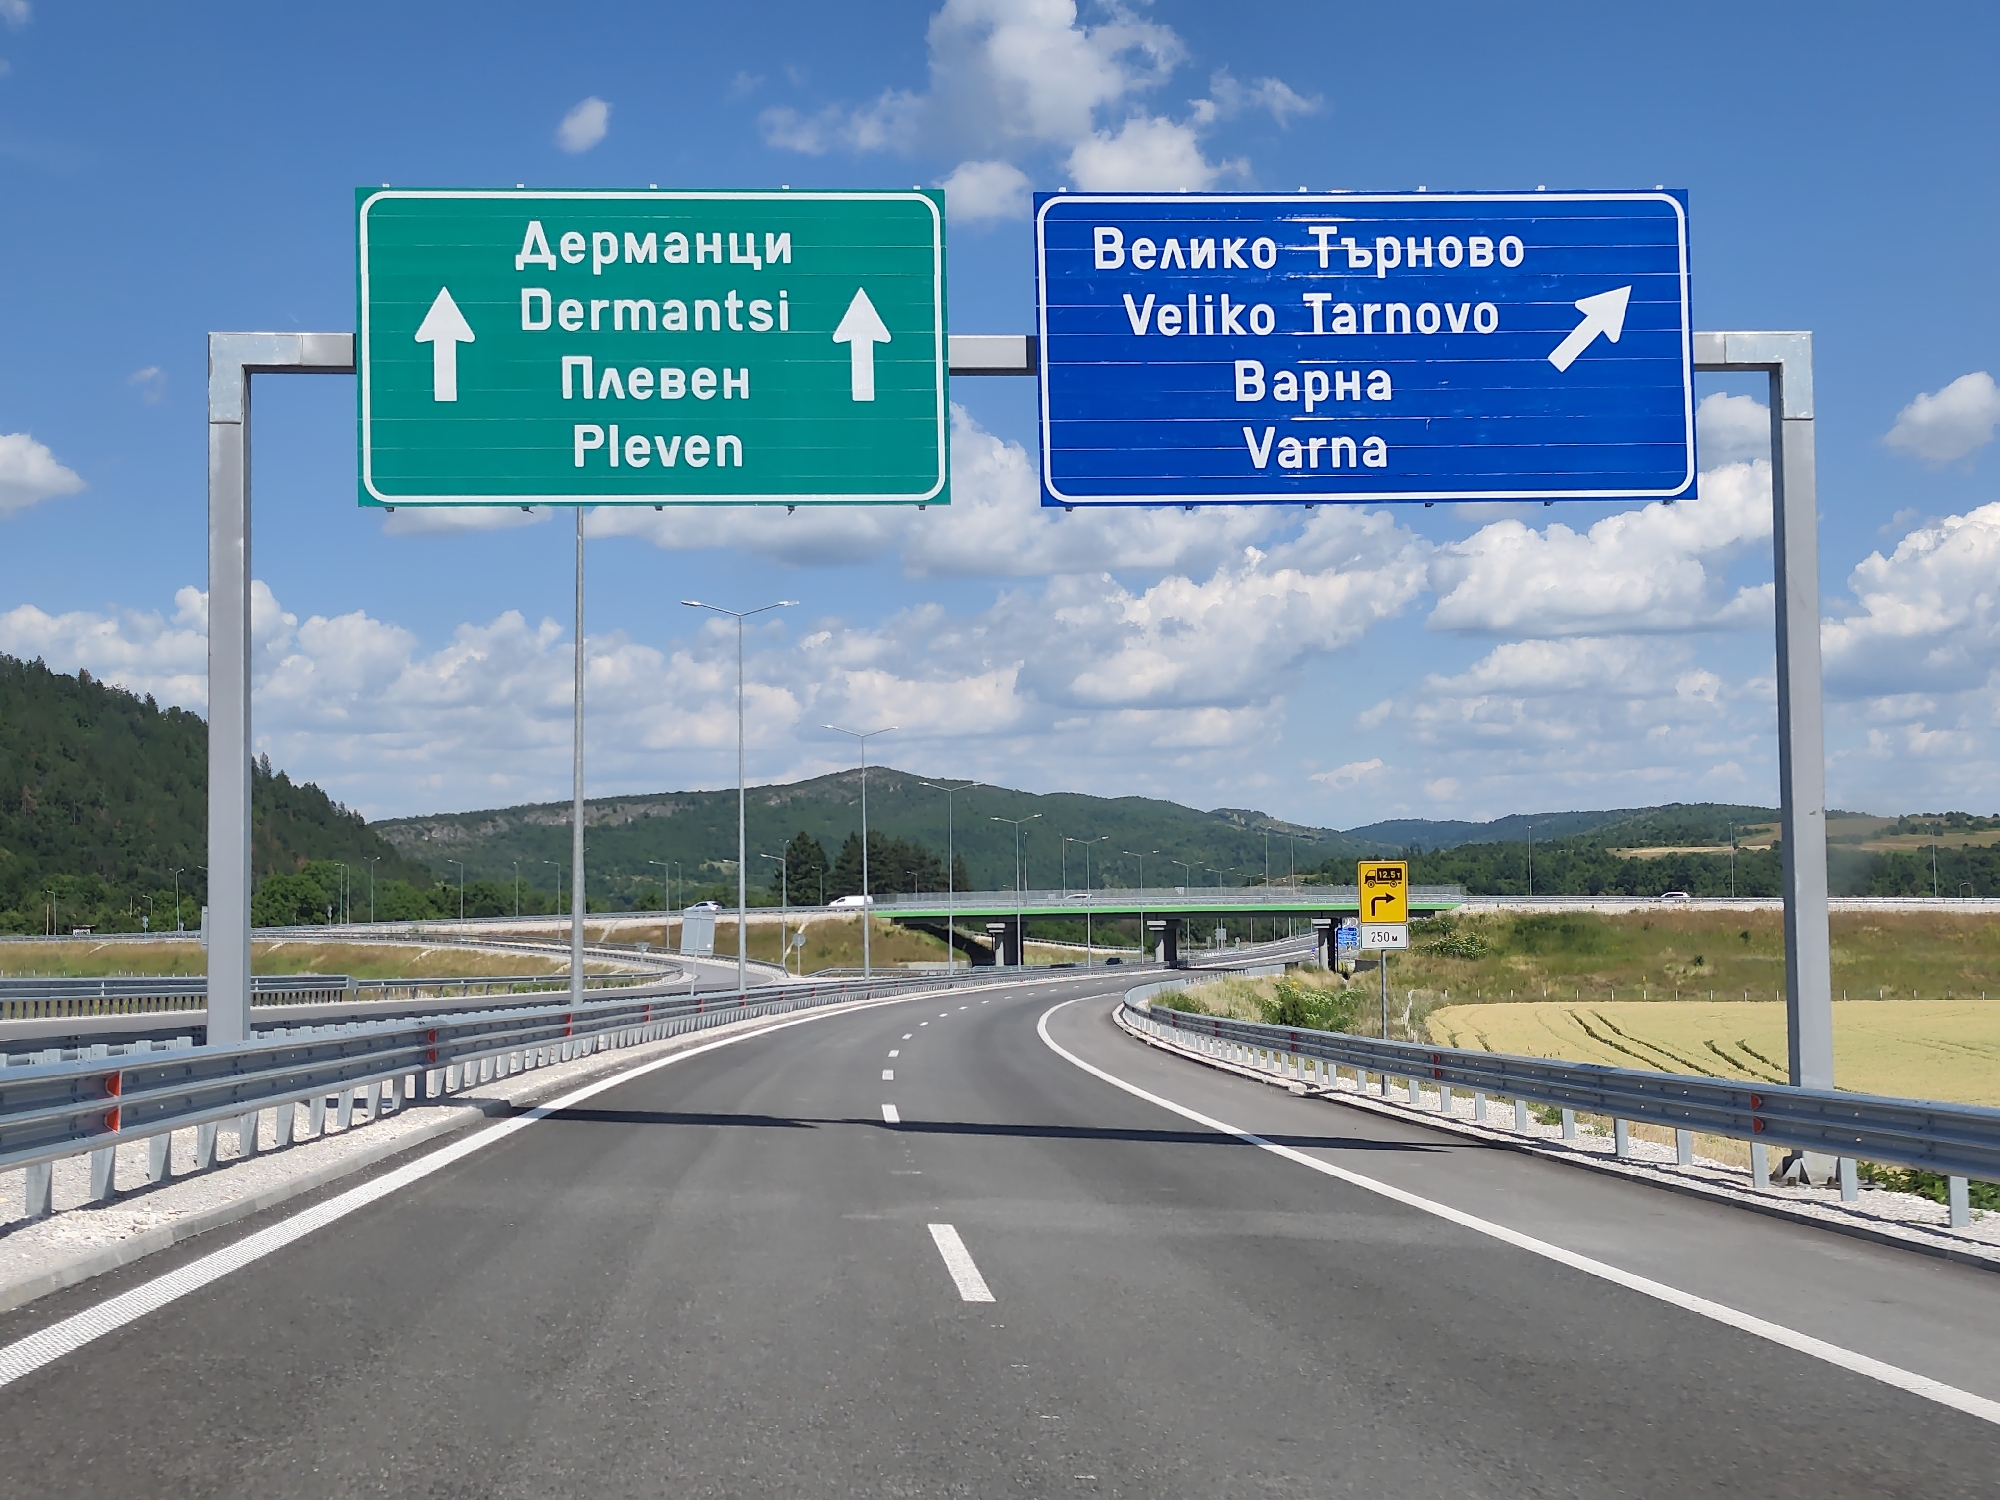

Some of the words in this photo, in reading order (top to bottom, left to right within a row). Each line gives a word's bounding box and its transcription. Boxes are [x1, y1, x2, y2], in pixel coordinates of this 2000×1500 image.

[515, 220, 792, 275] Дерманци
[1093, 226, 1278, 270] Велико
[1308, 226, 1525, 279] Търново
[521, 287, 789, 332] Dermantsi
[1122, 293, 1276, 337] Veliko
[1302, 292, 1499, 334] Tarnovo
[561, 355, 749, 401] Плевен
[1234, 359, 1392, 413] Варна
[574, 424, 743, 468] Pleven
[1242, 426, 1388, 469] Varna
[1370, 931, 1390, 943] 250
